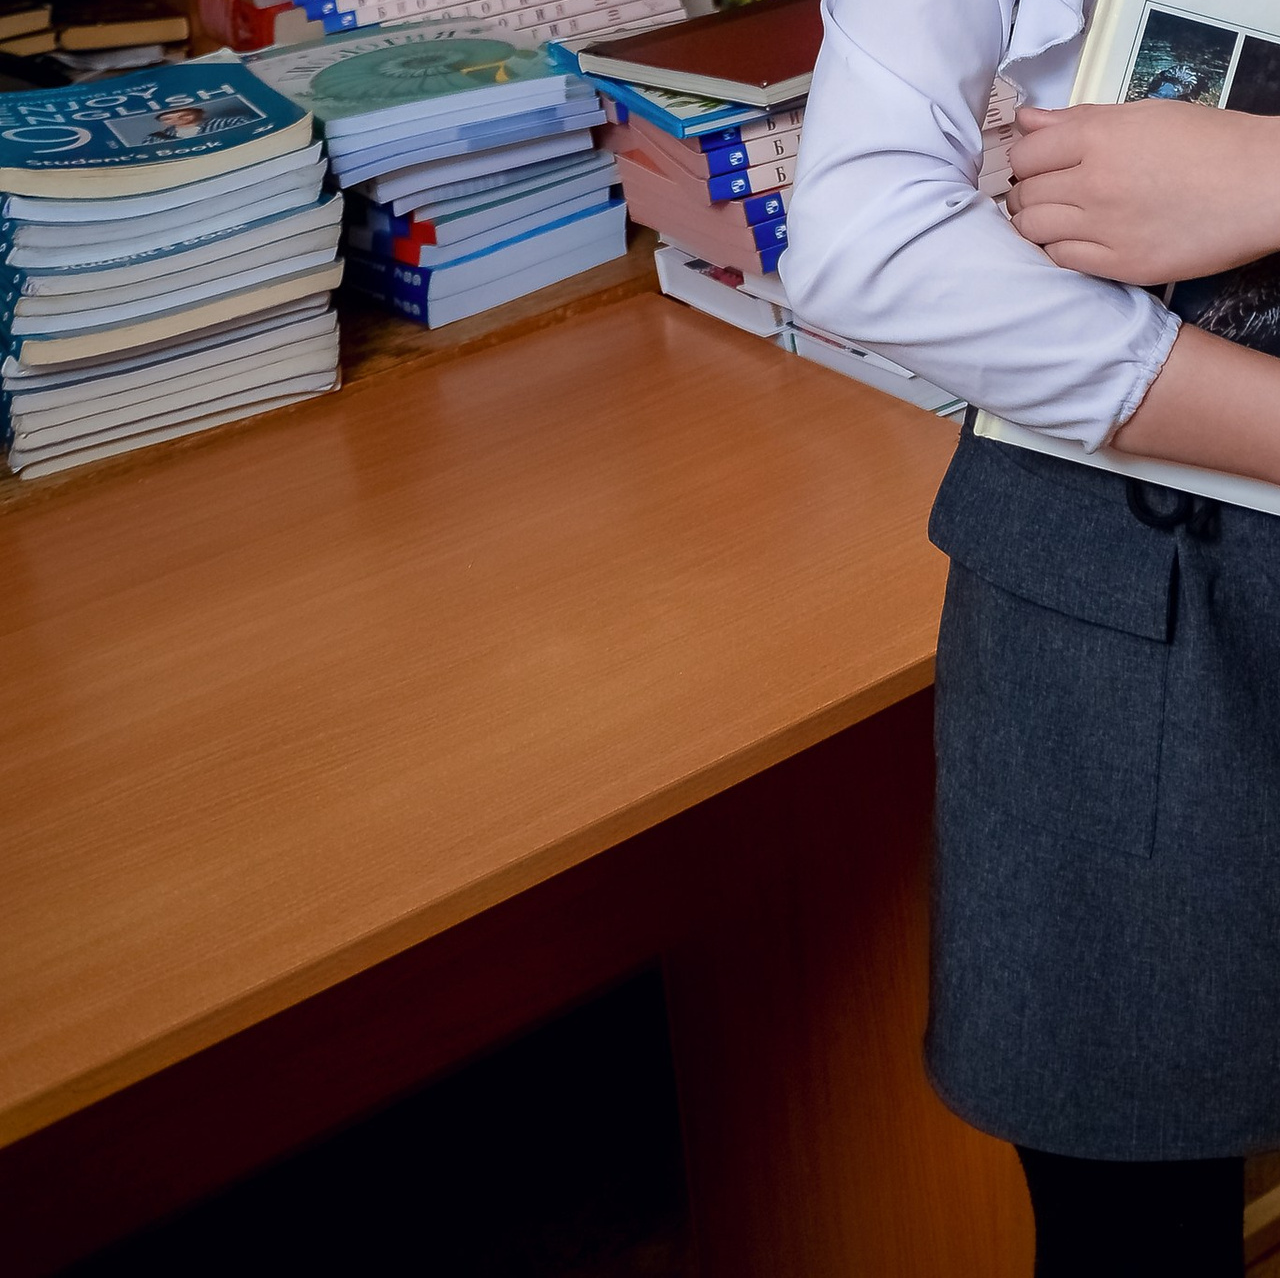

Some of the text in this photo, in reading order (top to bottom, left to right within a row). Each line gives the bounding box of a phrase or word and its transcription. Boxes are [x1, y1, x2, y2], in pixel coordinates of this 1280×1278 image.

[1, 125, 92, 154] 9
[26, 140, 223, 166] Student's Book
